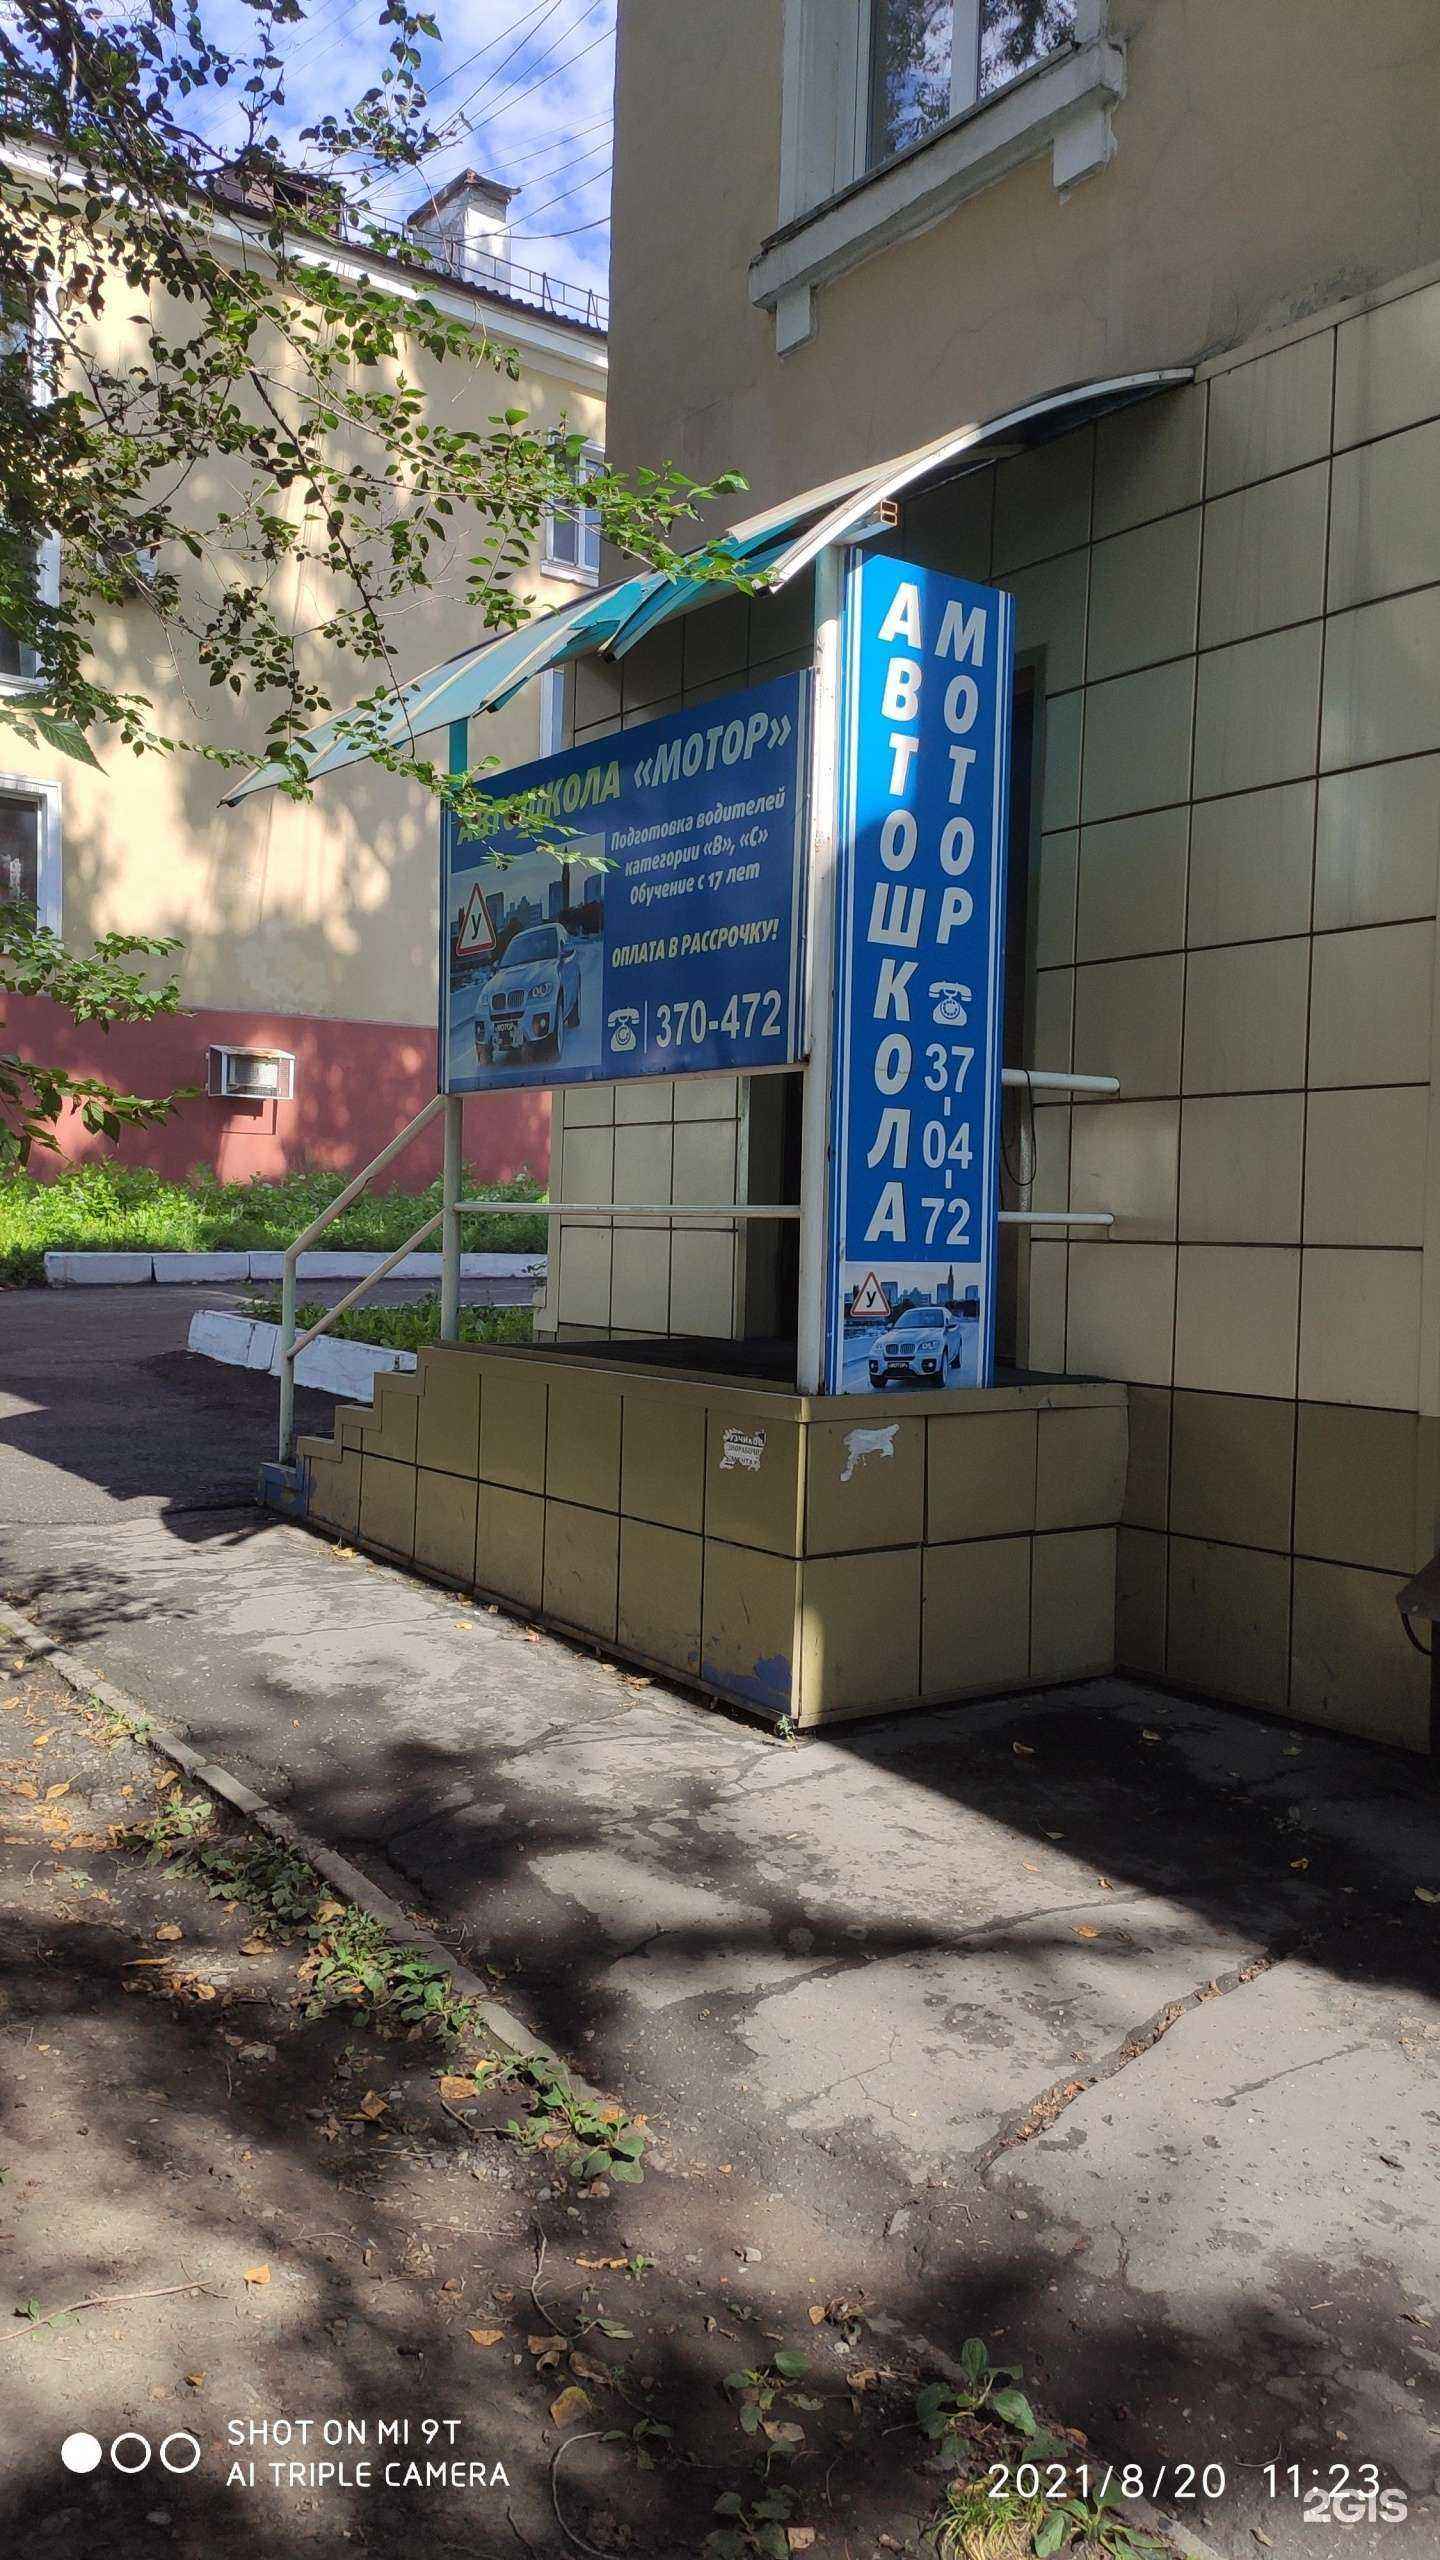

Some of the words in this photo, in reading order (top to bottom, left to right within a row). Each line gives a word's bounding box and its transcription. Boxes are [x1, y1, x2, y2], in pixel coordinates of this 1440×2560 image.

[633, 712, 792, 789] «МОТОР»
[935, 600, 987, 945] МОТОР
[611, 815, 693, 852] Подготовка
[696, 785, 786, 829] водителей
[625, 844, 700, 877] категории
[630, 877, 696, 907] Обучение
[708, 870, 724, 891] 17
[726, 862, 761, 884] лет
[612, 939, 665, 968] ОПЛАТА
[668, 936, 679, 959] В
[681, 918, 780, 956] РАССРОЧКУ!
[864, 582, 926, 1243] АВТОШКОЛА
[656, 989, 782, 1048] 370-472
